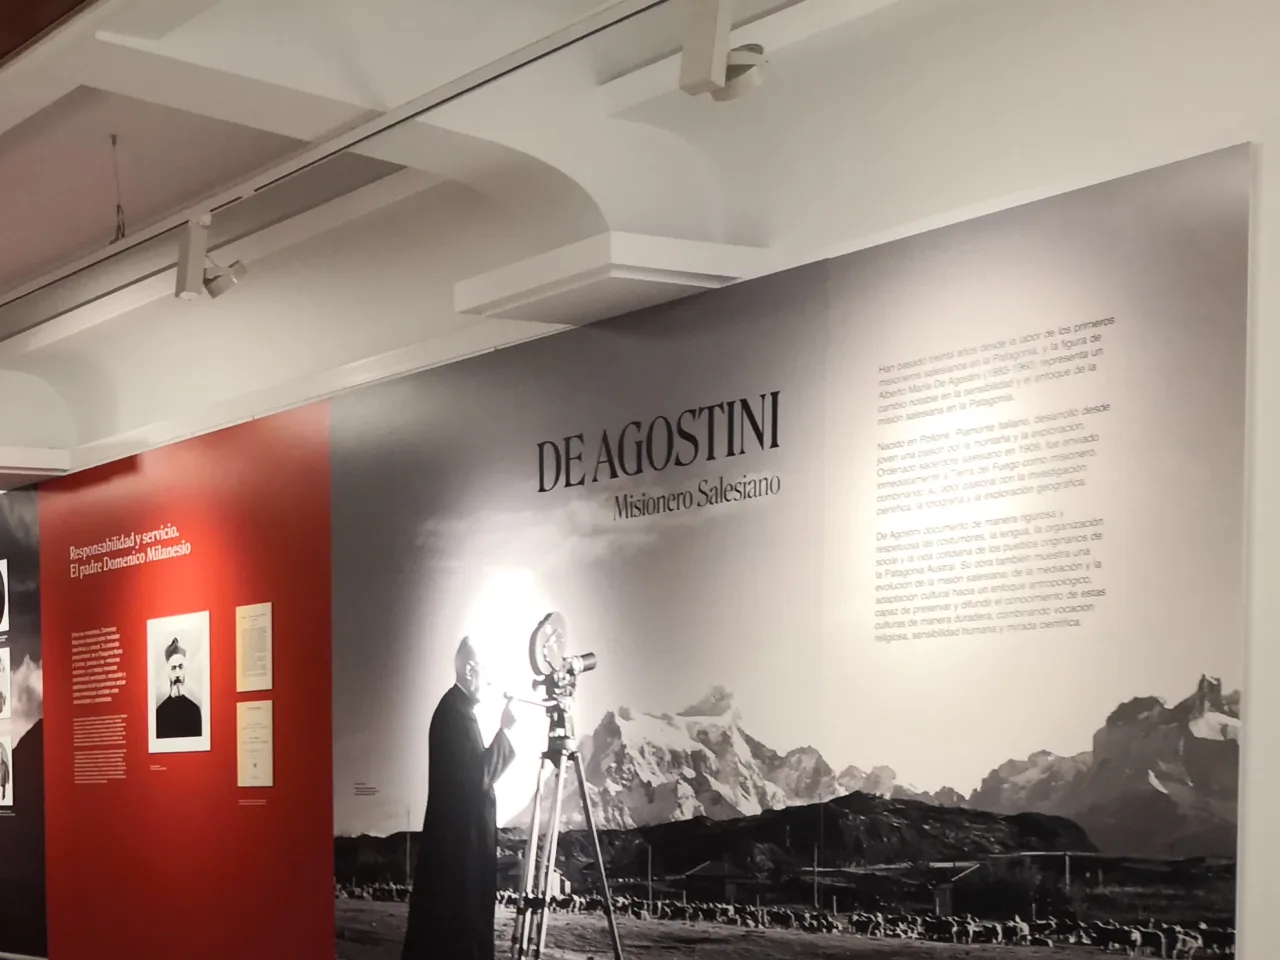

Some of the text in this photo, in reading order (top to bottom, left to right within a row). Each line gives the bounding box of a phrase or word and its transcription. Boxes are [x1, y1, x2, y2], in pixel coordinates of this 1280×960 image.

[537, 391, 780, 493] DE AGOSTINI
[613, 474, 780, 521] Misionero Salesiano
[70, 523, 179, 560] Responsabilidad y servicio.
[70, 540, 191, 579] El padre Domenico Milanesio
